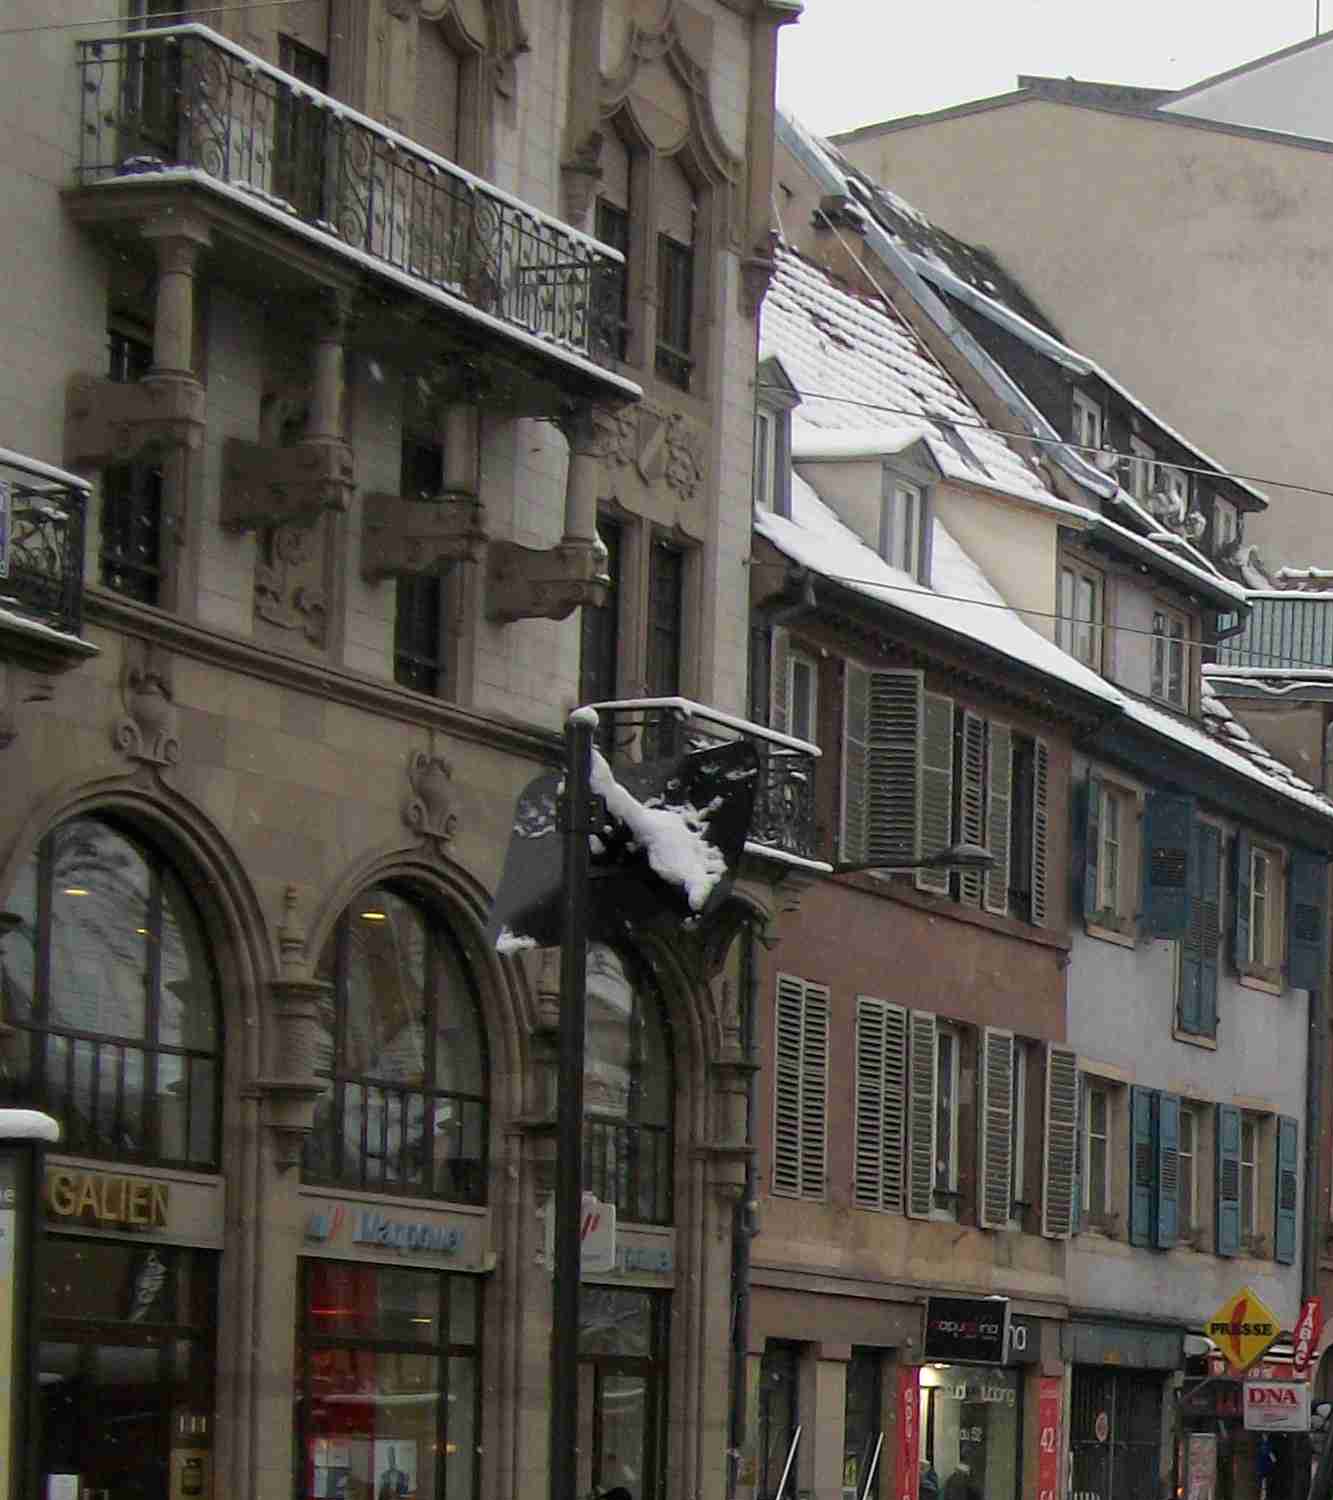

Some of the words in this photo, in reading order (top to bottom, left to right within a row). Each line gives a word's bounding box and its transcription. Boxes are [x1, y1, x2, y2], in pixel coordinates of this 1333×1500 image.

[51, 1172, 169, 1227] GALIEN
[1210, 1322, 1274, 1336] PRESSE
[1248, 1388, 1297, 1404] DNA
[1039, 1426, 1055, 1453] 42
